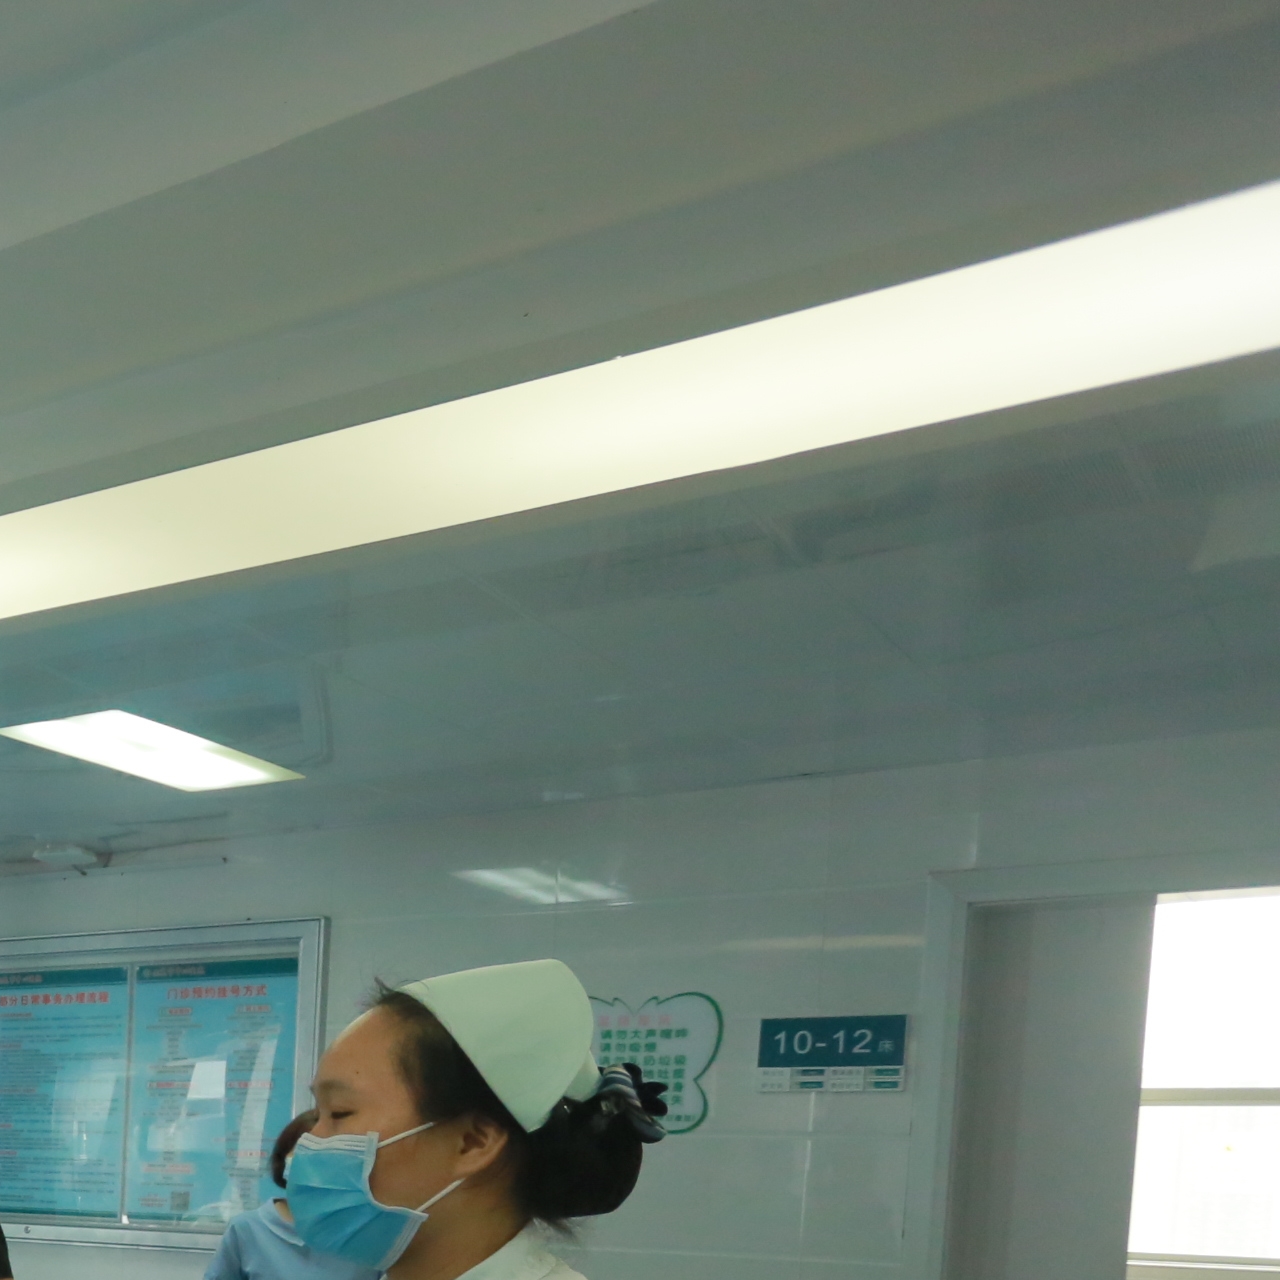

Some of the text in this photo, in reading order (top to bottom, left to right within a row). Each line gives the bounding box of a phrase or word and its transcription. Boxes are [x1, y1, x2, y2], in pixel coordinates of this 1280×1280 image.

[167, 984, 268, 1000] 门诊预约挂号方式
